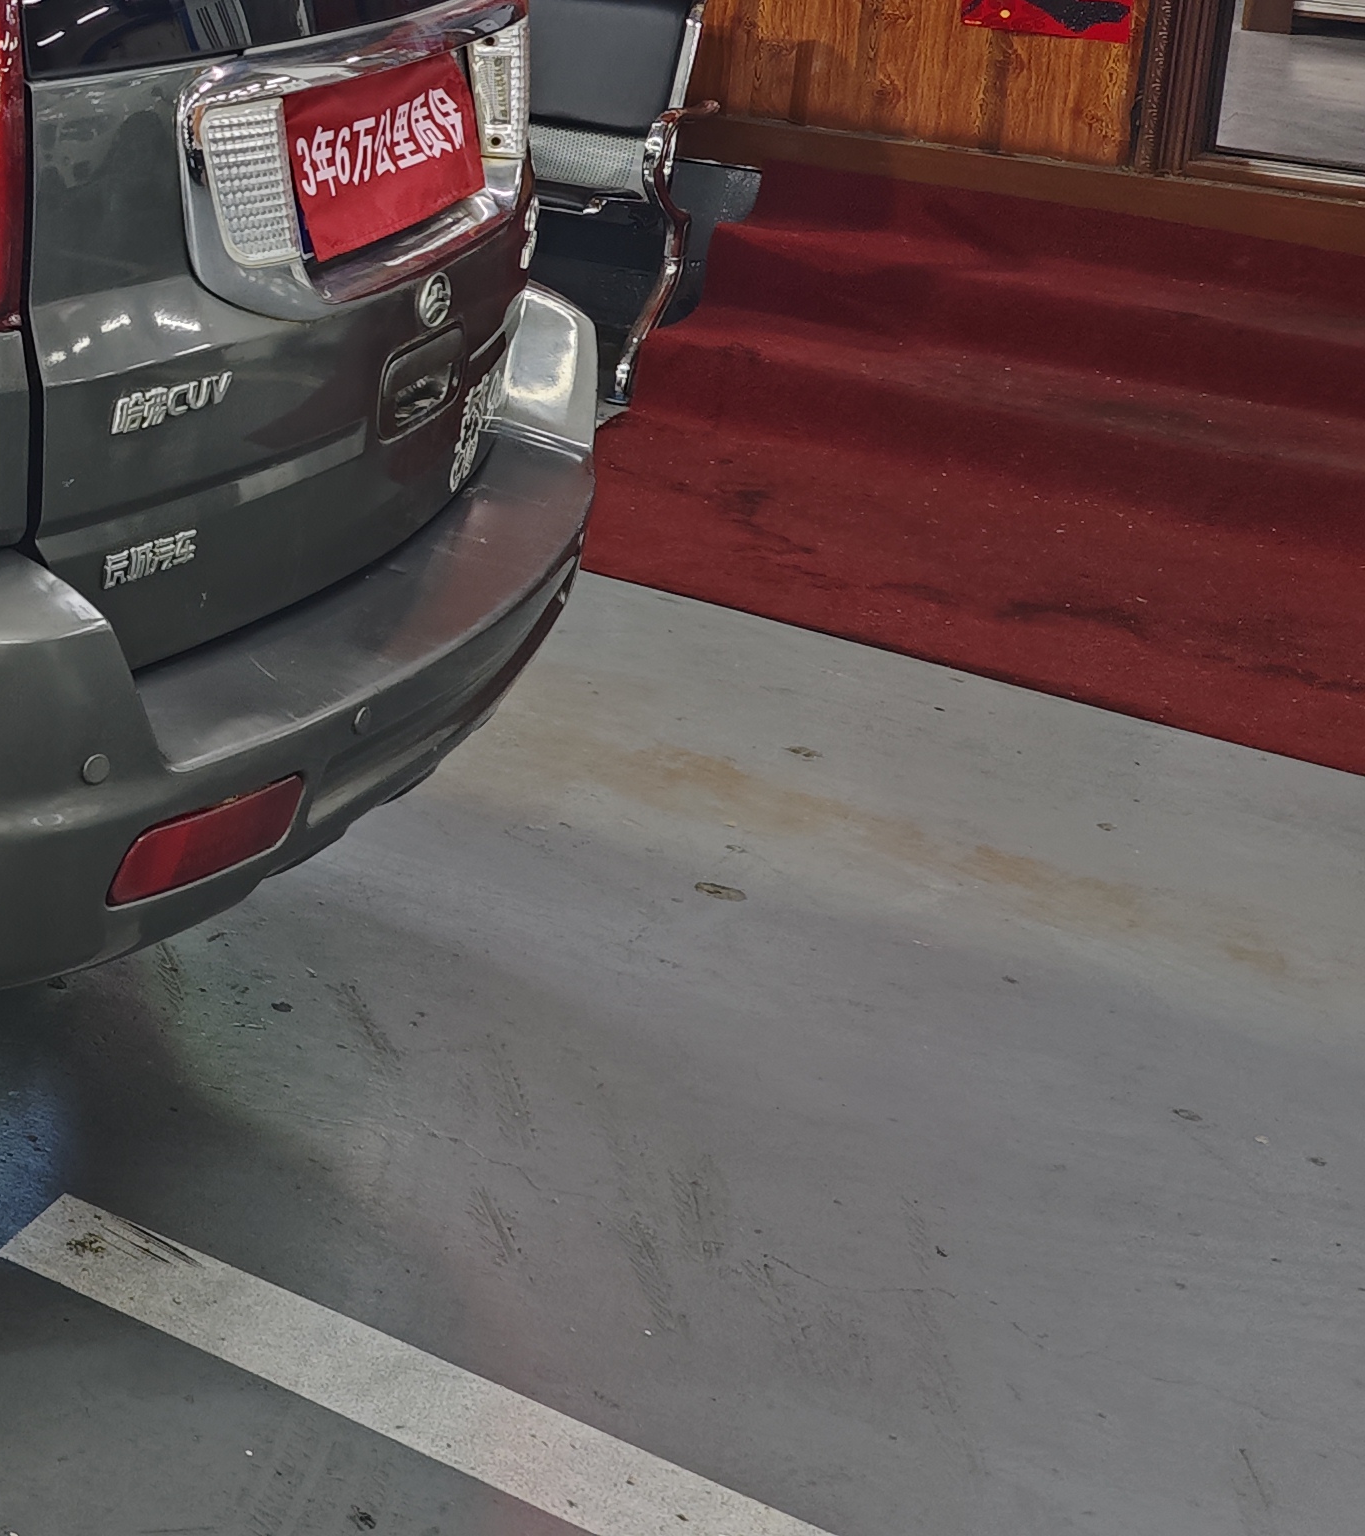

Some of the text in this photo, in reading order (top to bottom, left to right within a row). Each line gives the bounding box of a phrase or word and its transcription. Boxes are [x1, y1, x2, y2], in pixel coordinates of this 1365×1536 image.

[296, 87, 466, 197] 3年6万公里质保
